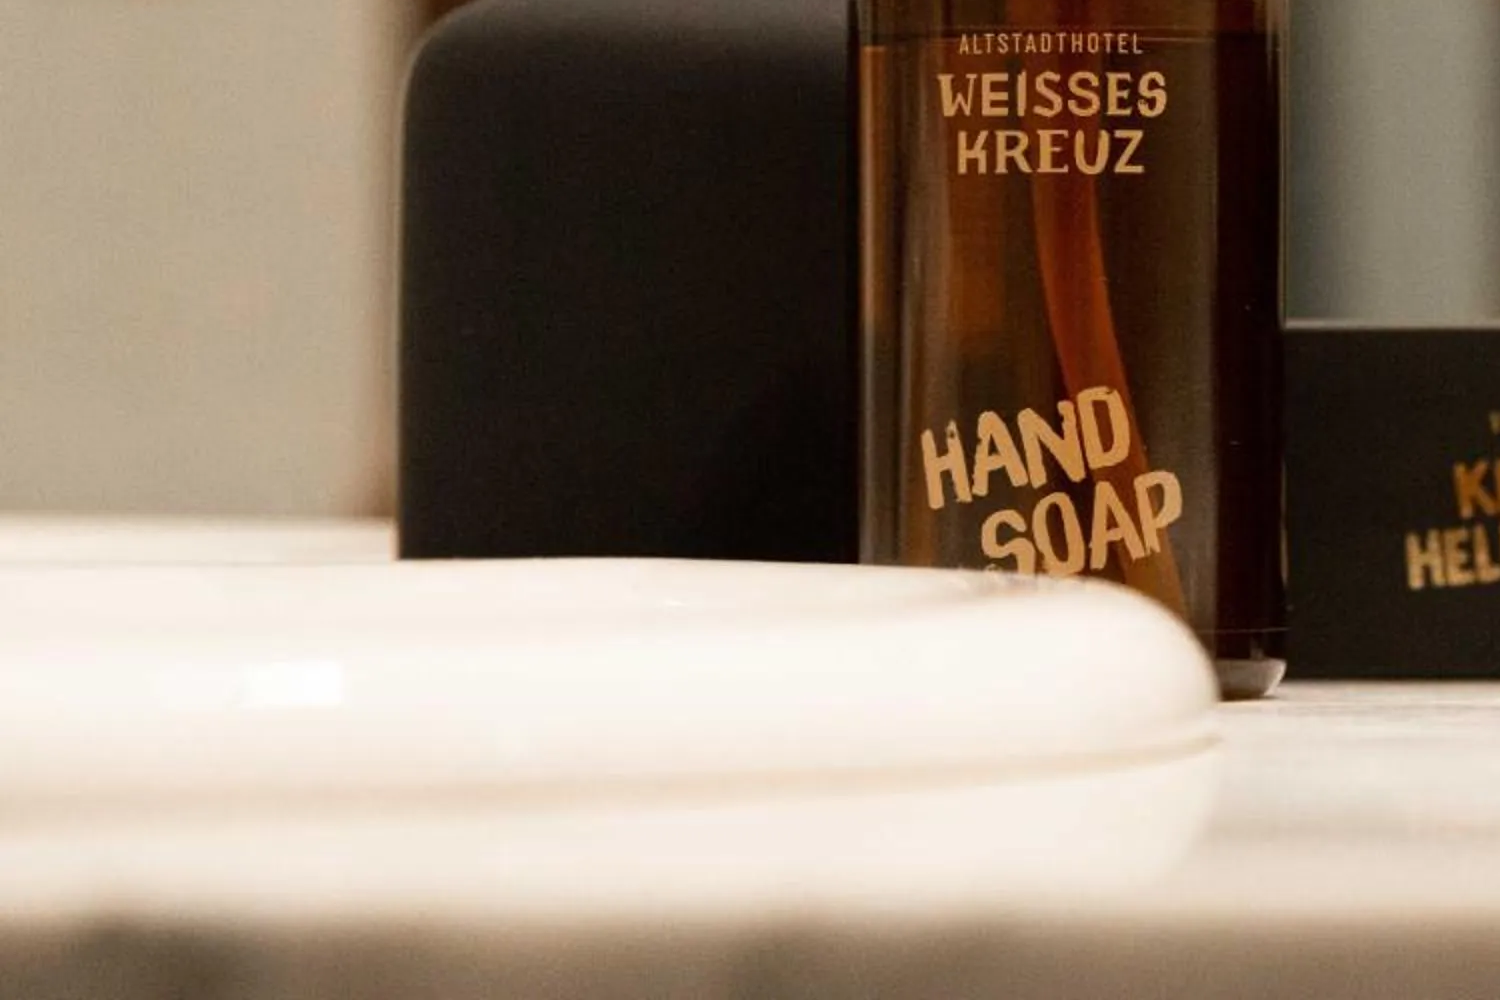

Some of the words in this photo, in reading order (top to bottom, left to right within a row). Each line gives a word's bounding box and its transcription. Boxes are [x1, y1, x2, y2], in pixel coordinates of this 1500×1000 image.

[958, 32, 1144, 55] ALTSTADTHOTEL
[937, 70, 1167, 118] WEISSES
[957, 129, 1146, 175] KREUZ
[920, 385, 1131, 509] HAND
[980, 470, 1183, 577] SOAP
